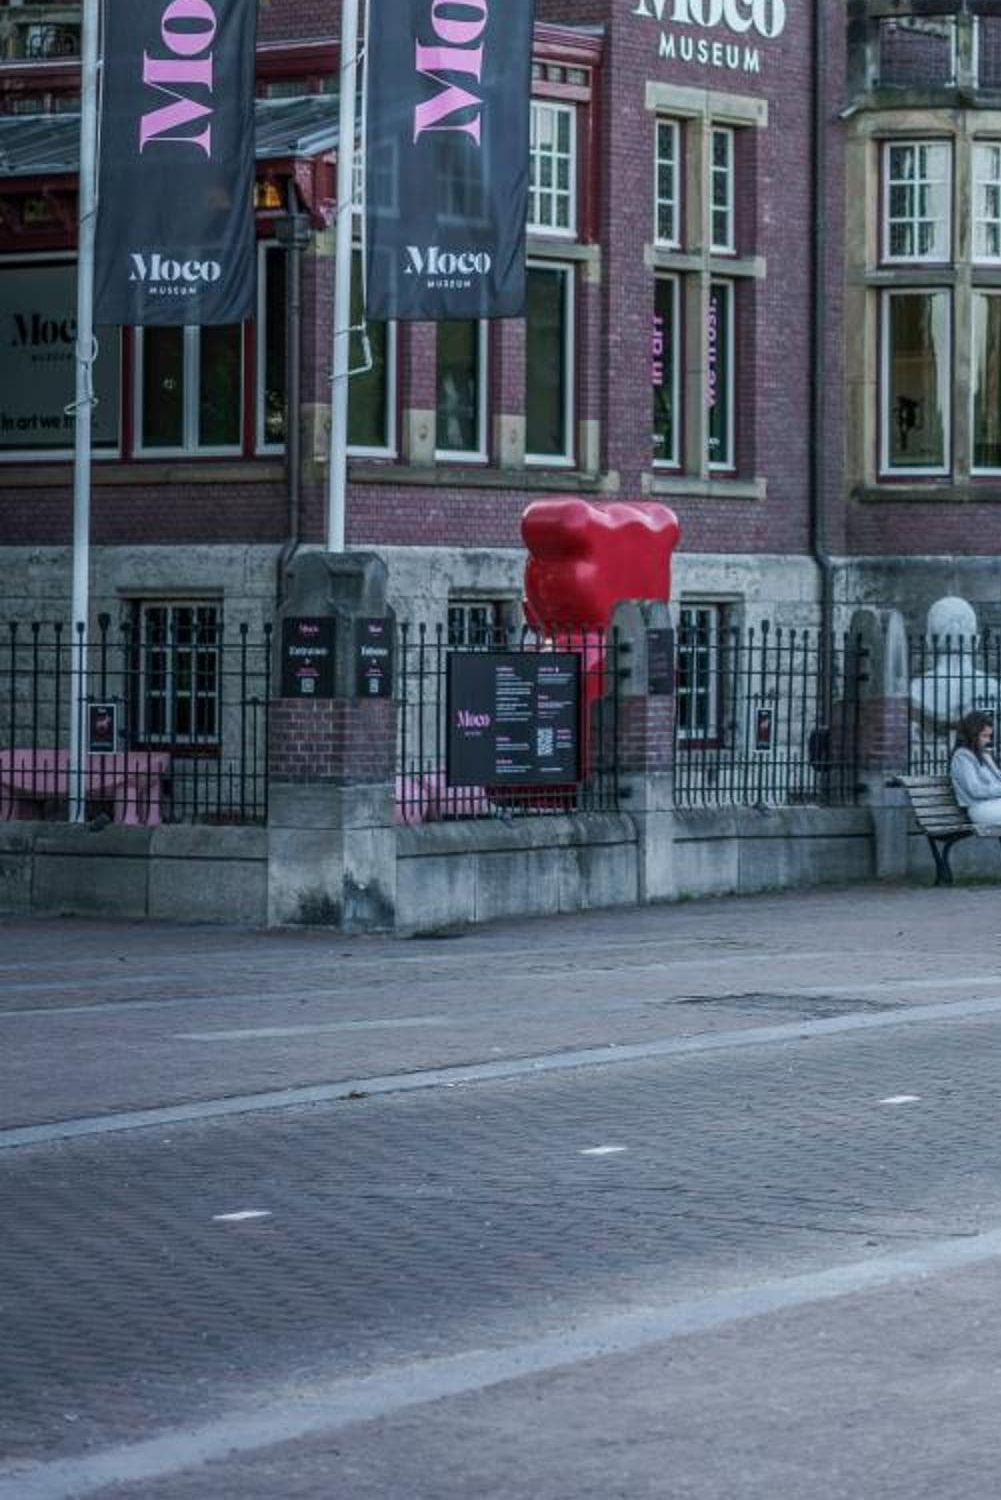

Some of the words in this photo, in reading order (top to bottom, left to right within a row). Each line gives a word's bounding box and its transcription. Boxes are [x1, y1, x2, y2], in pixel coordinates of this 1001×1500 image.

[658, 31, 761, 74] MUSEUM
[128, 252, 221, 281] Moco
[403, 244, 491, 276] Moco
[11, 312, 79, 347] Moc
